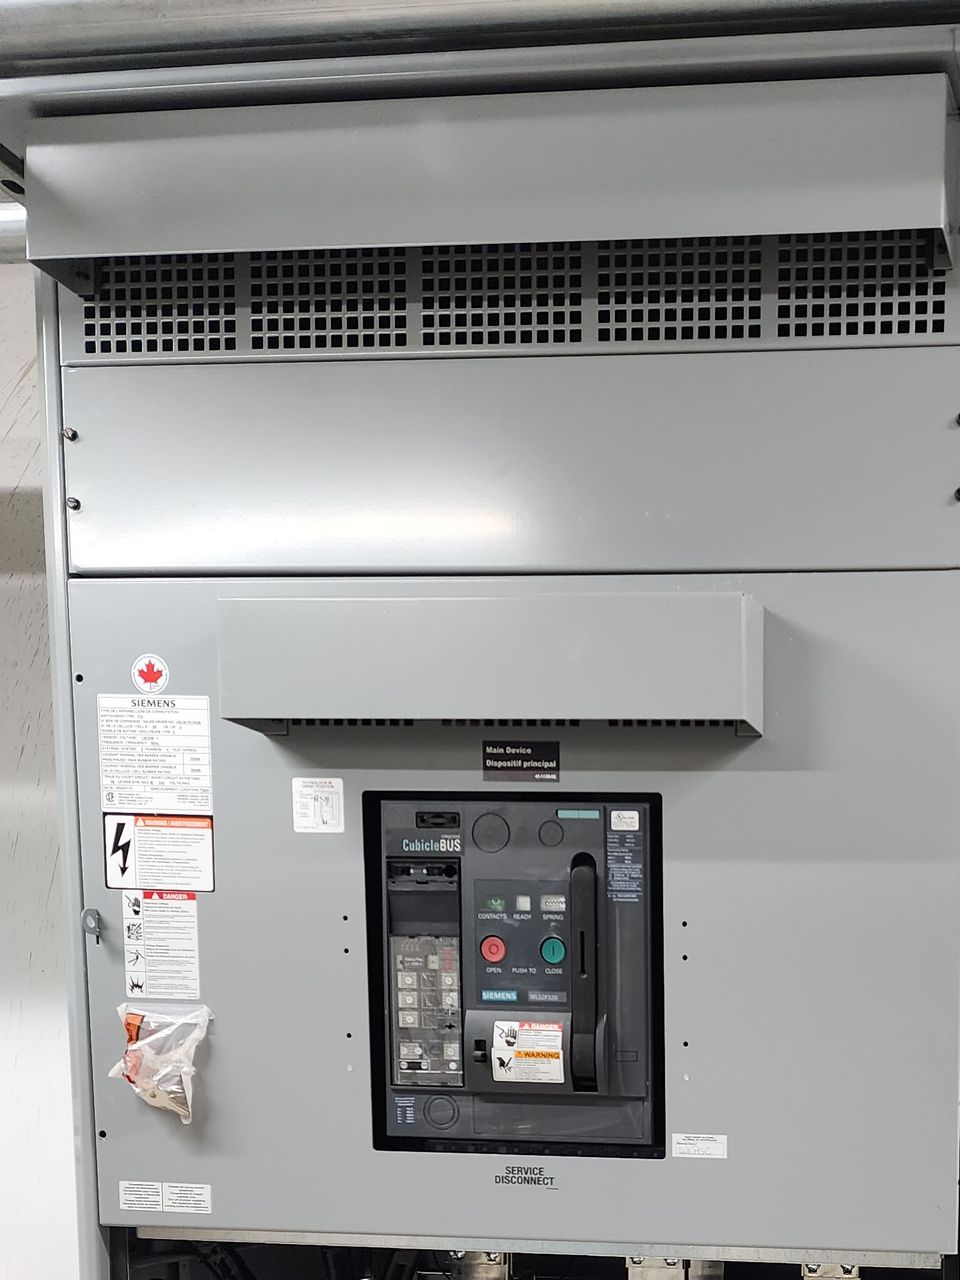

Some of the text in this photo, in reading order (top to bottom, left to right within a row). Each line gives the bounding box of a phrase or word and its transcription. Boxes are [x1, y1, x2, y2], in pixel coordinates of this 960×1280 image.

[131, 699, 176, 708] SIEMENS
[485, 746, 532, 754] Main Device
[485, 759, 557, 769] Dispositif principal
[402, 838, 461, 852] CubicleBUS
[162, 892, 188, 900] DANGER
[477, 912, 508, 920] CONTACTS
[542, 913, 564, 921] SPRING
[485, 966, 502, 974] OPEN
[544, 967, 563, 975] CLOSE
[481, 991, 517, 1001] SIEMENS
[523, 1051, 560, 1060] WARNING
[504, 1165, 545, 1176] SERVICE
[494, 1175, 555, 1186] DISCONNECT
